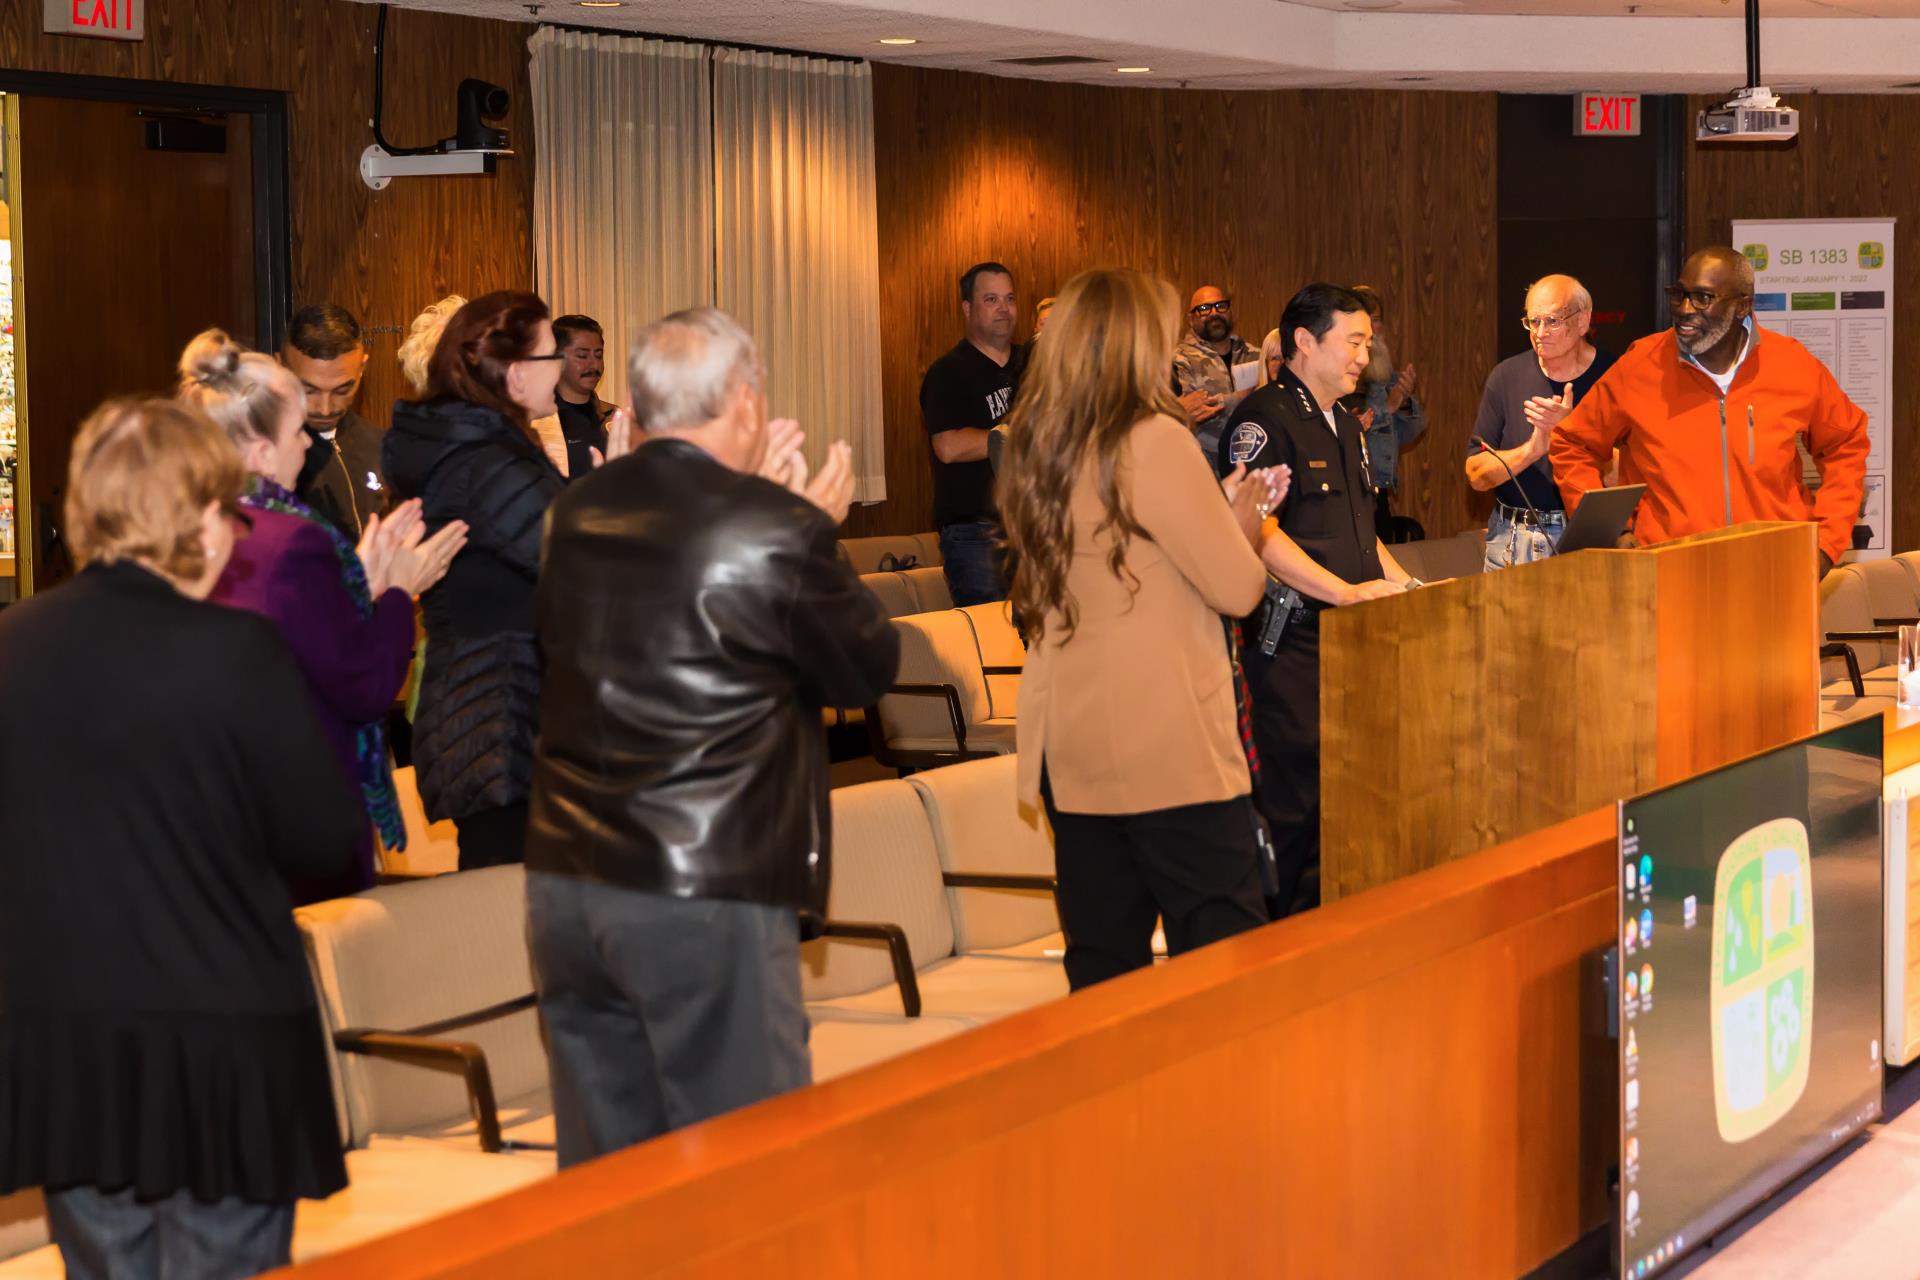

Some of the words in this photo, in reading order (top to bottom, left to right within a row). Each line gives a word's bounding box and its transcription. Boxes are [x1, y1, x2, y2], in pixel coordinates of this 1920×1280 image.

[1585, 96, 1637, 131] EXIT
[1780, 249, 1803, 265] SB
[1809, 248, 1848, 264] 1383
[1760, 276, 1801, 285] STARTING
[1802, 275, 1839, 284] JANUARY
[1849, 274, 1868, 283] 2022
